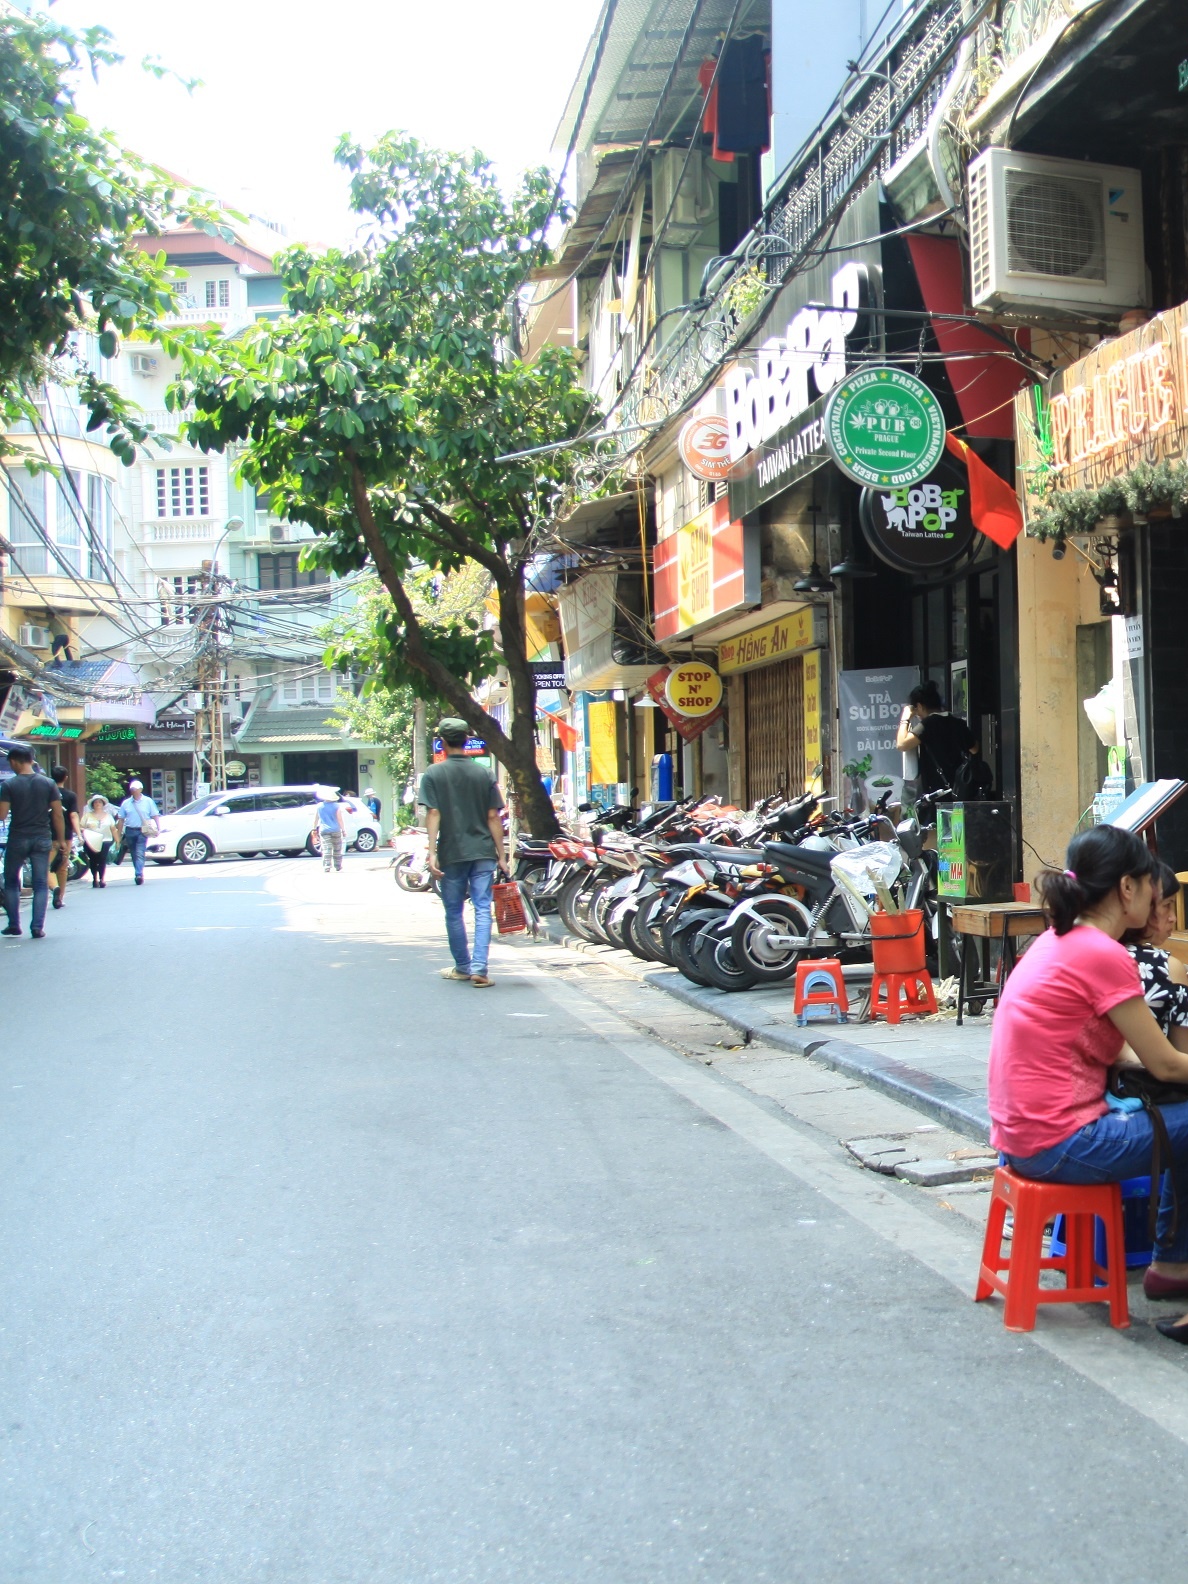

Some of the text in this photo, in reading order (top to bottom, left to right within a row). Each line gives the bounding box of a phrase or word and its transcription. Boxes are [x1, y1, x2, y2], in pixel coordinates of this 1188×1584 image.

[1049, 341, 1173, 471] PRAGUE
[831, 373, 941, 485] PIZZA PASTA VIETNAMESE FOOD BEER COCKTAILS
[866, 417, 906, 432] PUB
[790, 417, 827, 466] LATTEA
[874, 434, 900, 443] PRAGUE
[855, 446, 917, 459] Private Second Floor
[701, 458, 716, 468] SIM
[890, 484, 958, 509] BoBa
[908, 506, 957, 531] PoP
[691, 522, 709, 567] STOP
[691, 570, 709, 614] SHOP
[720, 643, 735, 660] Shop
[770, 625, 788, 654] AN
[678, 672, 712, 683] STOP
[688, 685, 702, 694] N'
[868, 690, 892, 704] TRÀ
[678, 697, 713, 707] SHOP
[849, 704, 876, 720] SỦI
[857, 738, 899, 751] ĐÀI LOA
